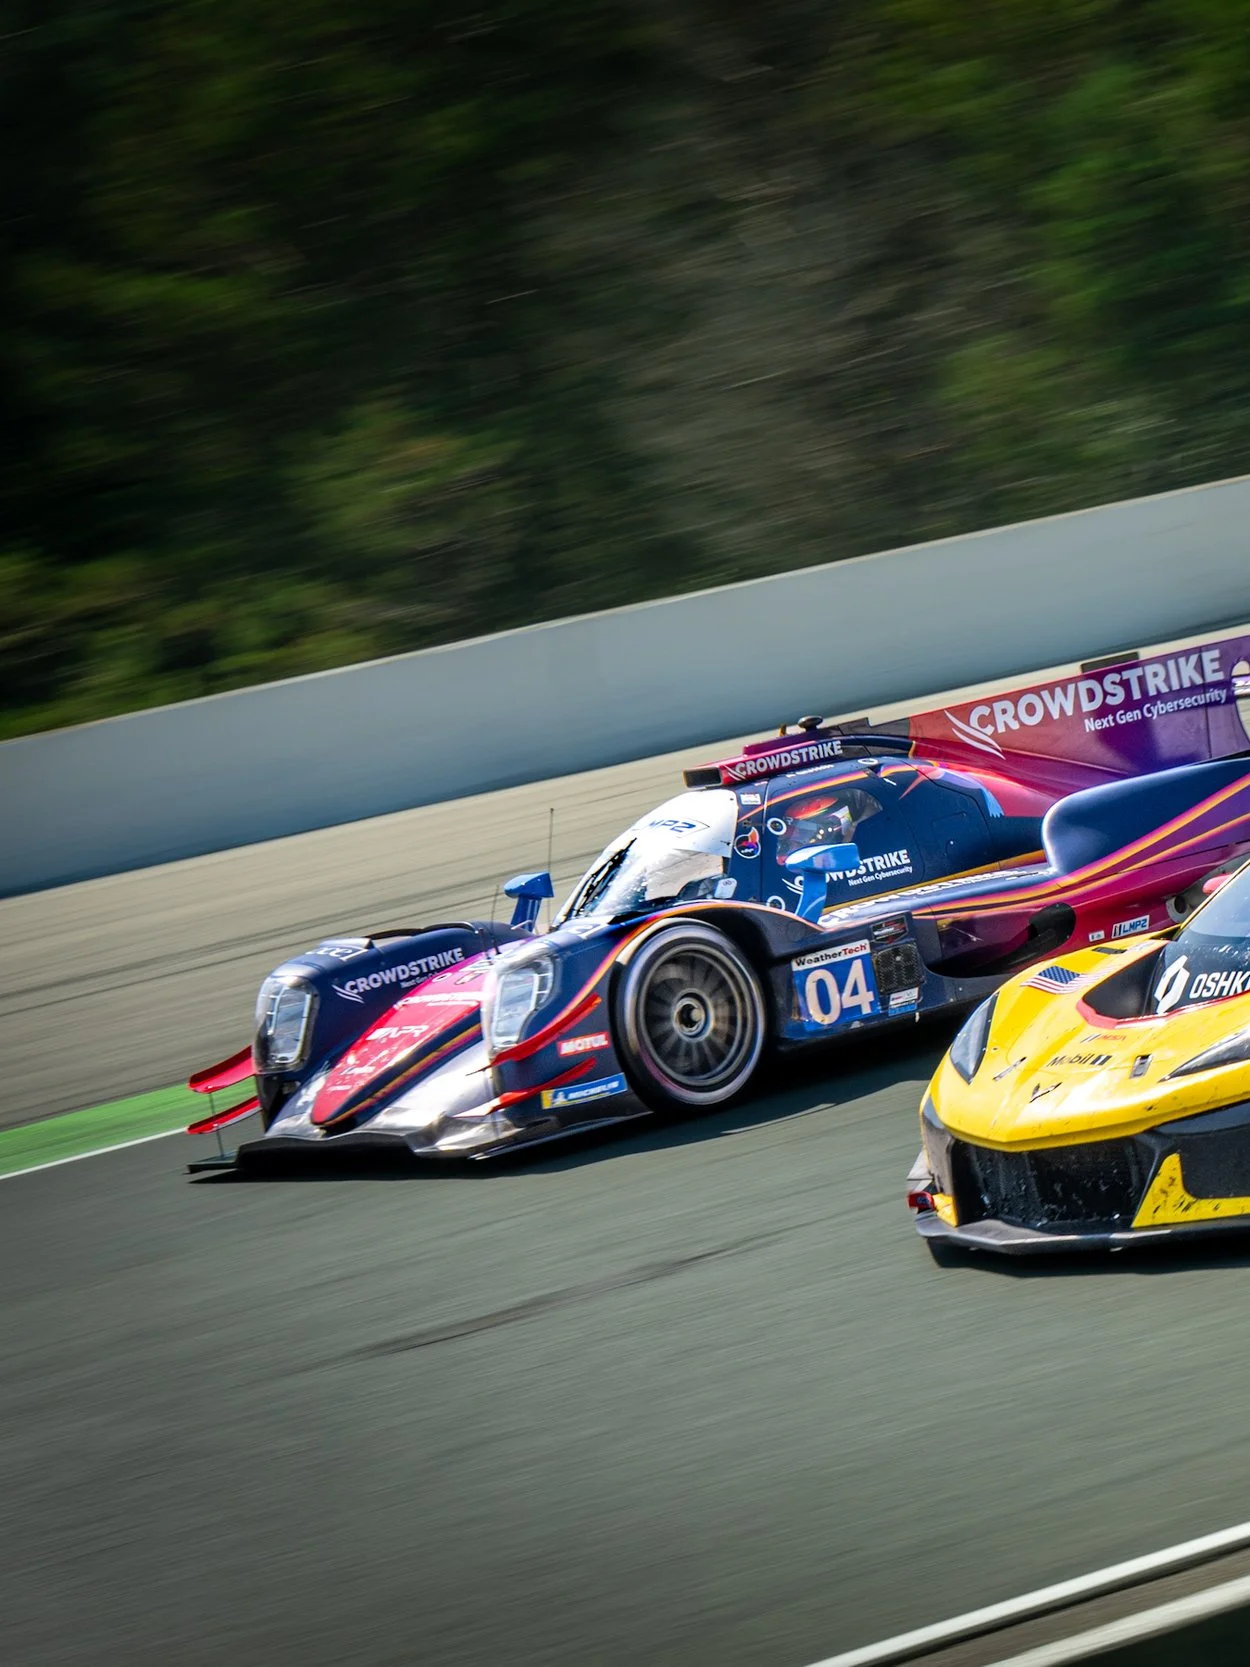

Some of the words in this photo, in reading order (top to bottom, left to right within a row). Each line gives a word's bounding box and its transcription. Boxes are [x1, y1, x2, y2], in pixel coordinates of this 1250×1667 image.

[969, 650, 1224, 736] CROWDSTRIKE
[1085, 713, 1114, 733] Next
[1116, 711, 1142, 723] Gen
[1143, 687, 1227, 720] Cybersecurity
[735, 740, 843, 777] CROWDSTRIKE
[848, 878, 863, 887] Next
[863, 875, 875, 883] Gen
[875, 865, 913, 881] Cybersecurity
[1123, 918, 1147, 933] LMP2
[344, 947, 465, 995] CROWDSTRIKE
[795, 943, 867, 967] WeatherTech
[805, 959, 875, 1025] 04
[561, 1034, 609, 1054] MOTUL
